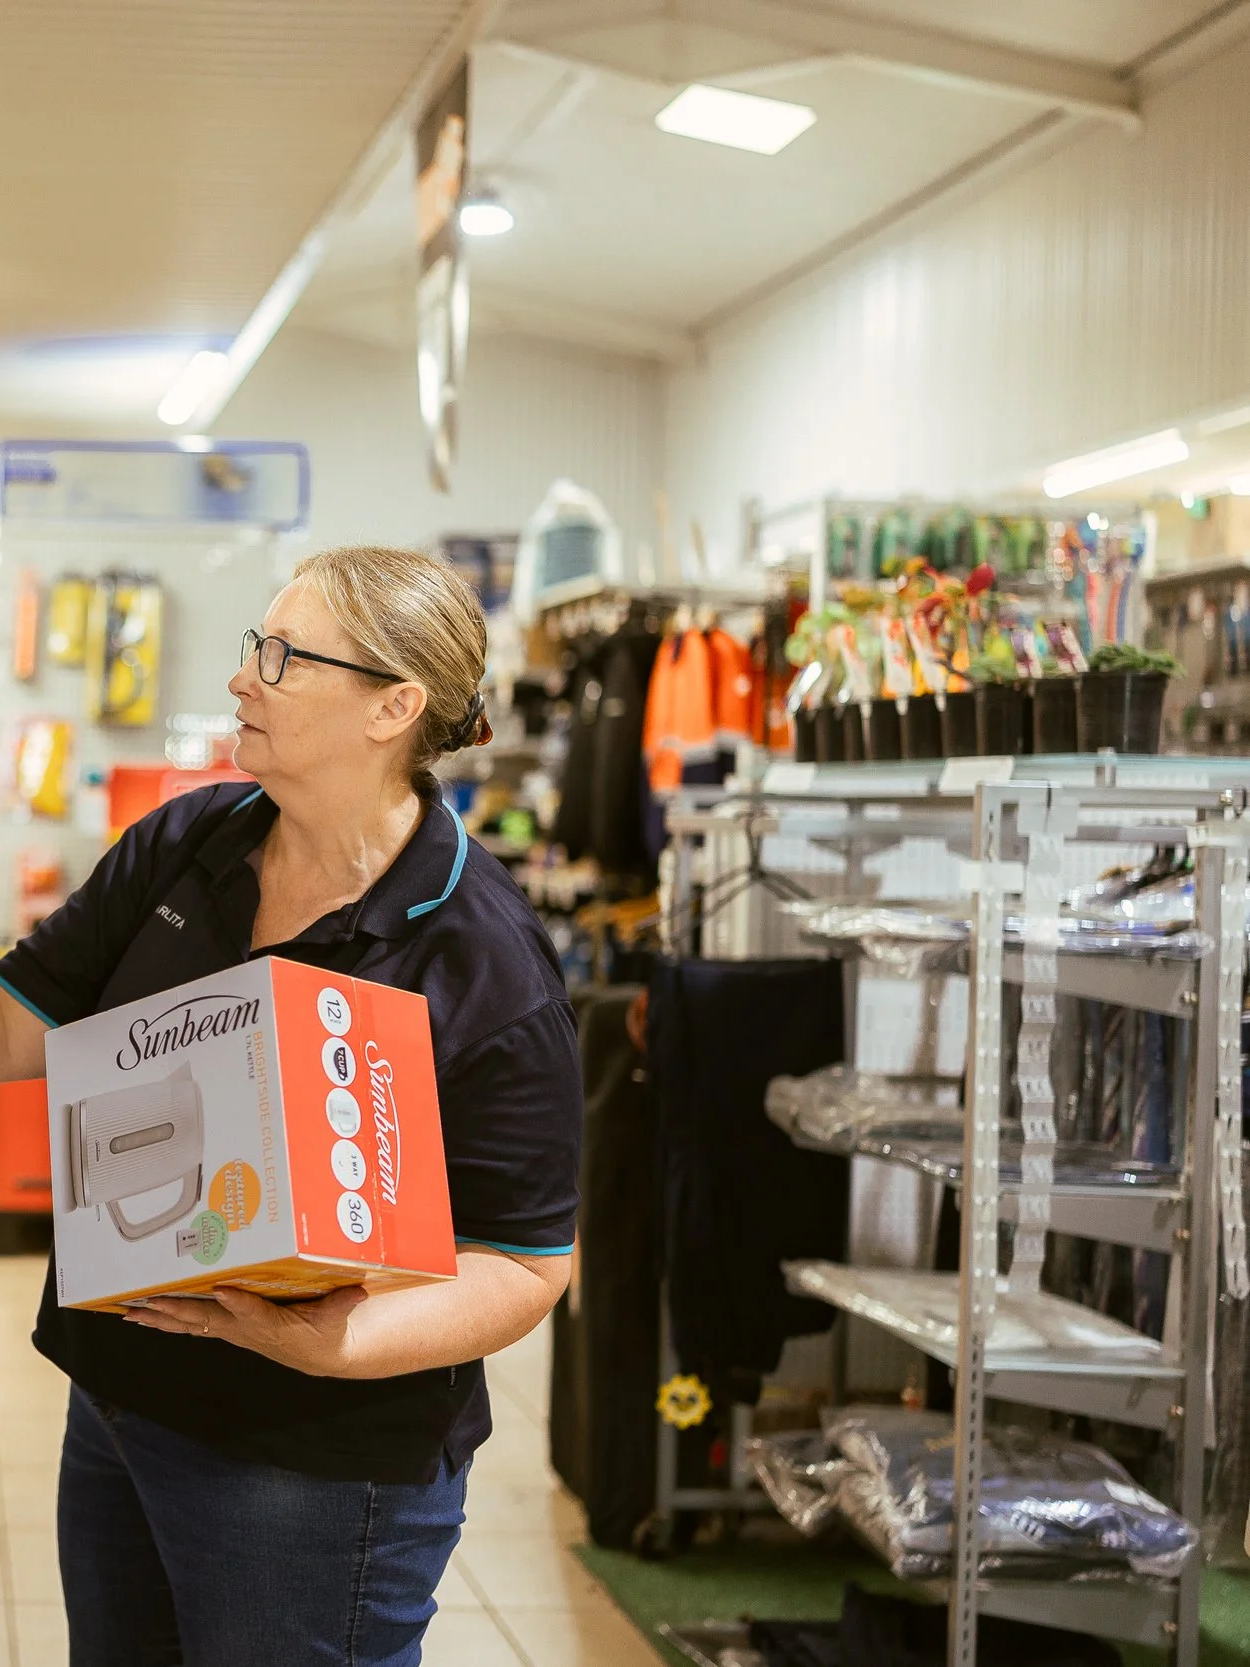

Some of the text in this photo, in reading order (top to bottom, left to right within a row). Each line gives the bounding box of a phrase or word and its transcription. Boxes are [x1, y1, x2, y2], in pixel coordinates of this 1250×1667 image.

[116, 995, 260, 1070] Sunbeam
[327, 999, 342, 1020] 12
[253, 1030, 279, 1223] BRIGHTSIDE COLLECTION
[364, 1040, 401, 1205] Sunbeam
[221, 1169, 235, 1224] design
[234, 1158, 251, 1229] textured
[348, 1199, 364, 1234] 360
